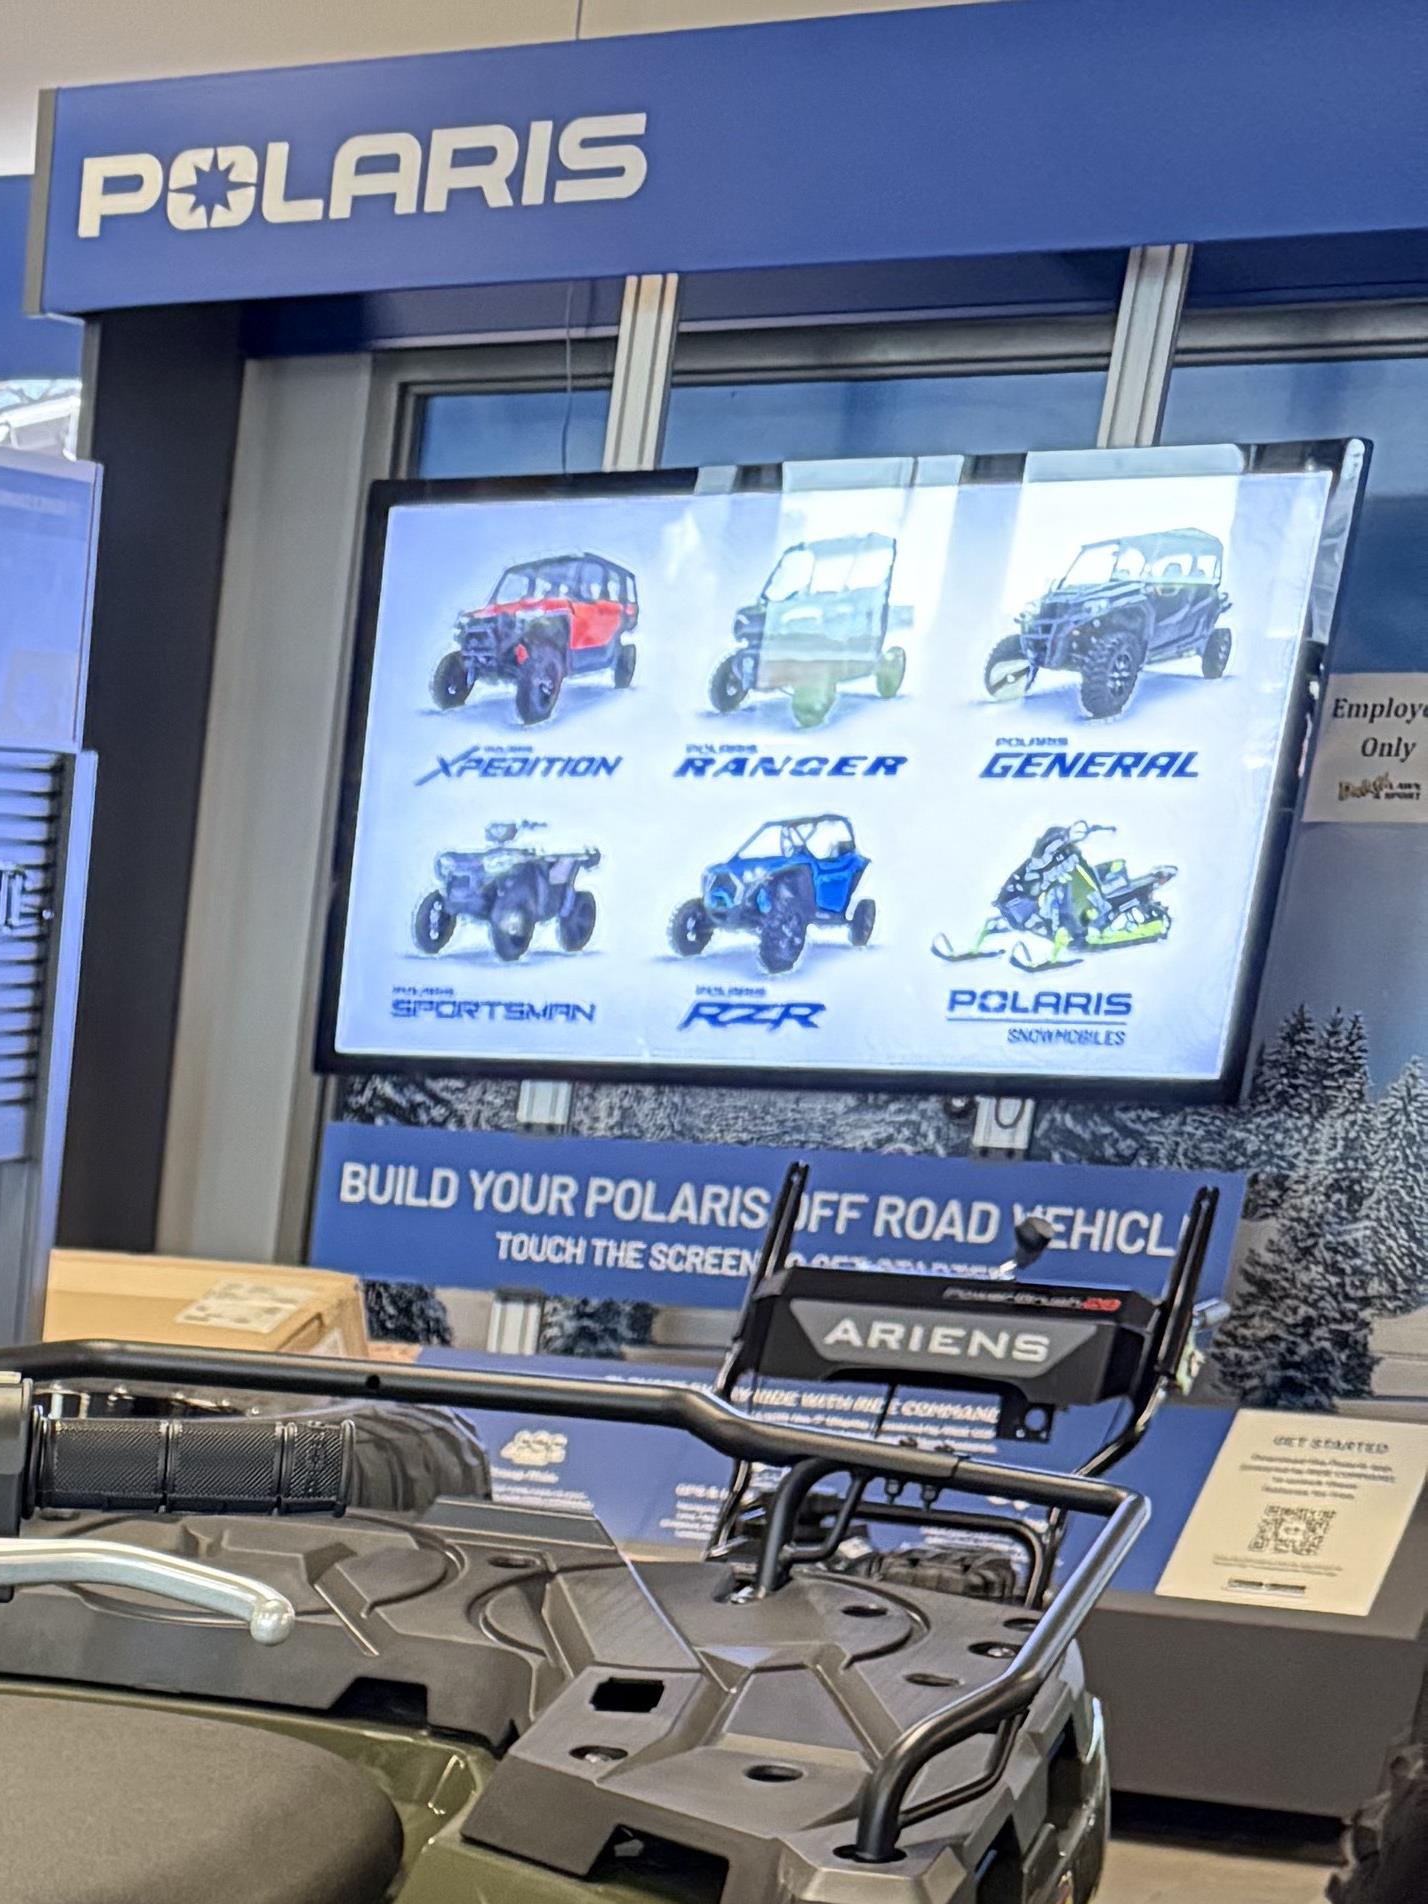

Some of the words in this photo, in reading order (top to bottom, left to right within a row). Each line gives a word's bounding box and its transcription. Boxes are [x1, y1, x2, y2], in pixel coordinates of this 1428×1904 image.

[77, 112, 648, 238] POLARIS
[995, 736, 1069, 748] POLARIS
[1361, 736, 1417, 763] Only
[413, 745, 623, 787] XPEDITION
[673, 755, 909, 778] RANGER
[978, 751, 1199, 779] GENERAL
[391, 999, 596, 1022] SPORTSMAN
[677, 1001, 827, 1031] RZR
[947, 989, 1133, 1016] POLARIS
[1007, 1027, 1126, 1047] SNOWMOBILES
[339, 1162, 460, 1209] BUILD
[469, 1169, 579, 1218] YOUR
[584, 1177, 772, 1229] POLARIS
[873, 1195, 1001, 1245] ROAD
[495, 1231, 584, 1266] TOUCH
[591, 1238, 646, 1270] THE
[649, 1243, 760, 1278] SCREEN
[823, 1317, 1050, 1363] ARIENS
[1273, 1435, 1307, 1449] GET
[1310, 1437, 1389, 1455] STARTED
